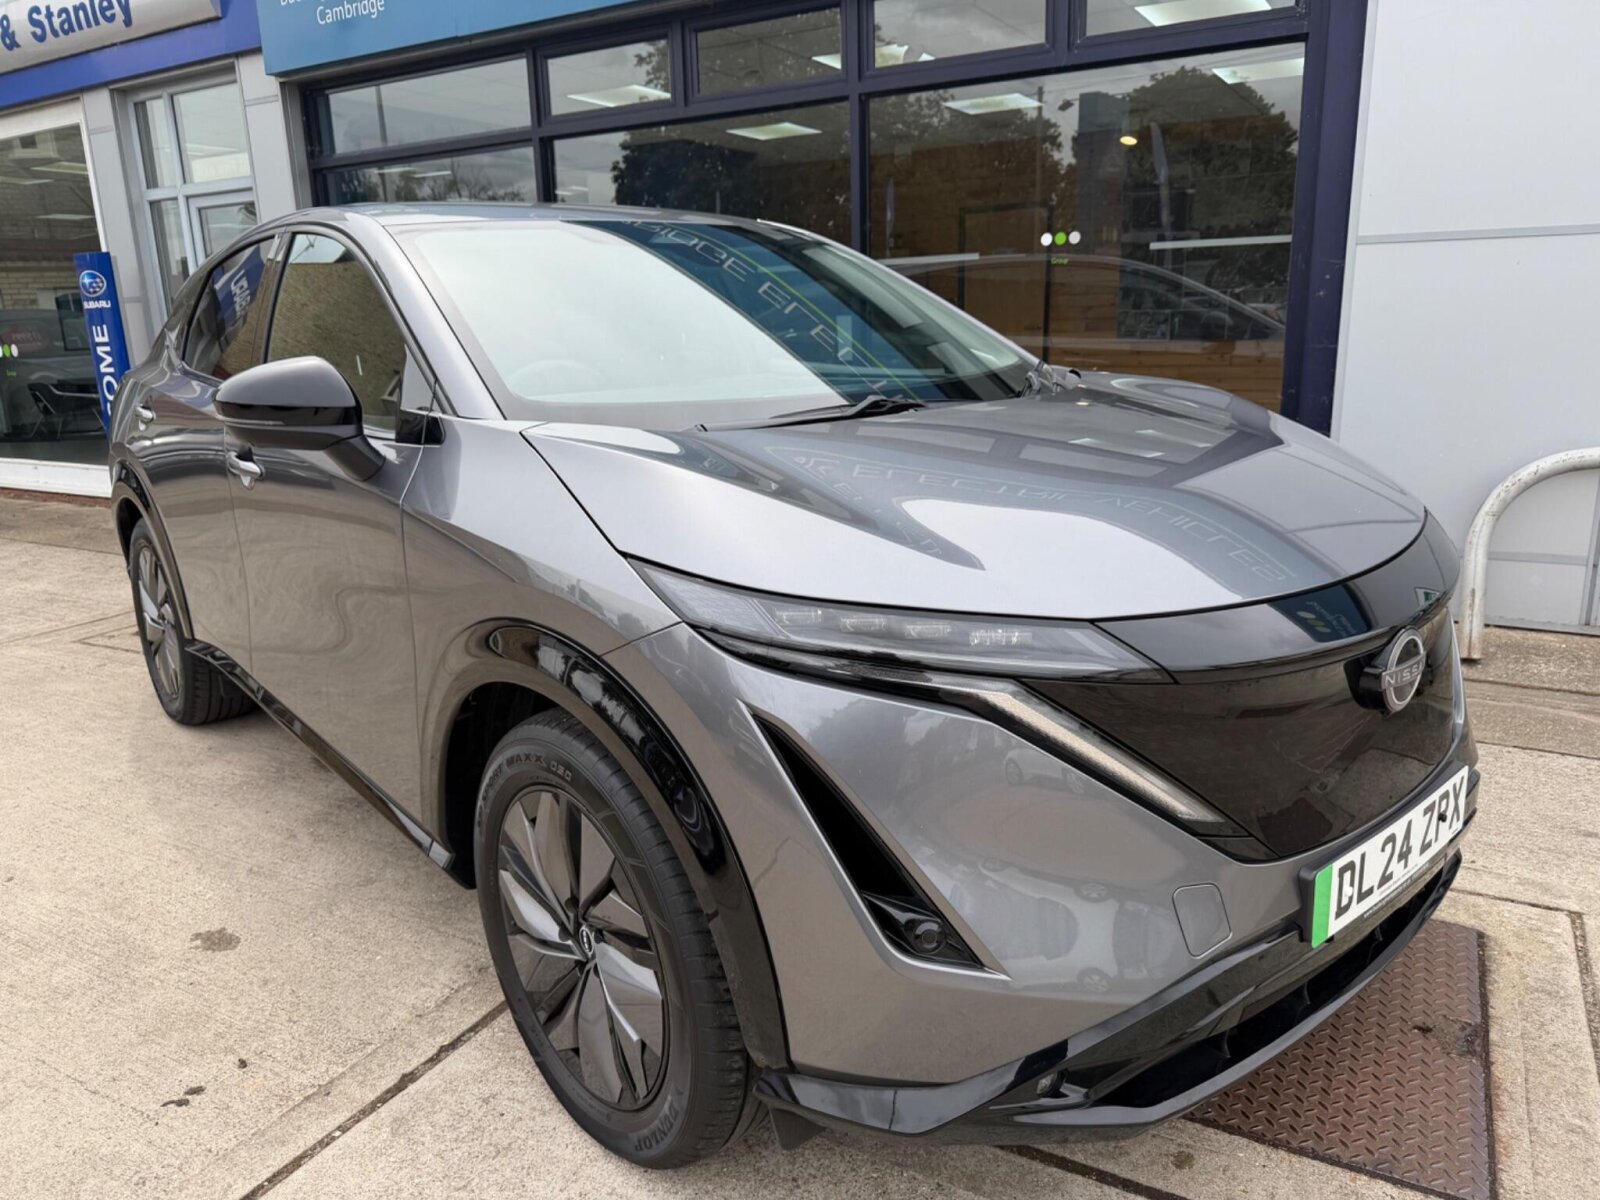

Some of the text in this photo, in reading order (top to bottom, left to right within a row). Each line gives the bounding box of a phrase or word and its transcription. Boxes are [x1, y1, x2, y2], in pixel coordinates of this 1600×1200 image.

[0, 0, 133, 51] & Stanley
[316, 0, 385, 25] Cambridge
[83, 300, 111, 310] SUBARU
[1334, 818, 1412, 921] DL24
[1419, 774, 1465, 857] ZPX
[634, 1101, 681, 1152] DUNLOP
